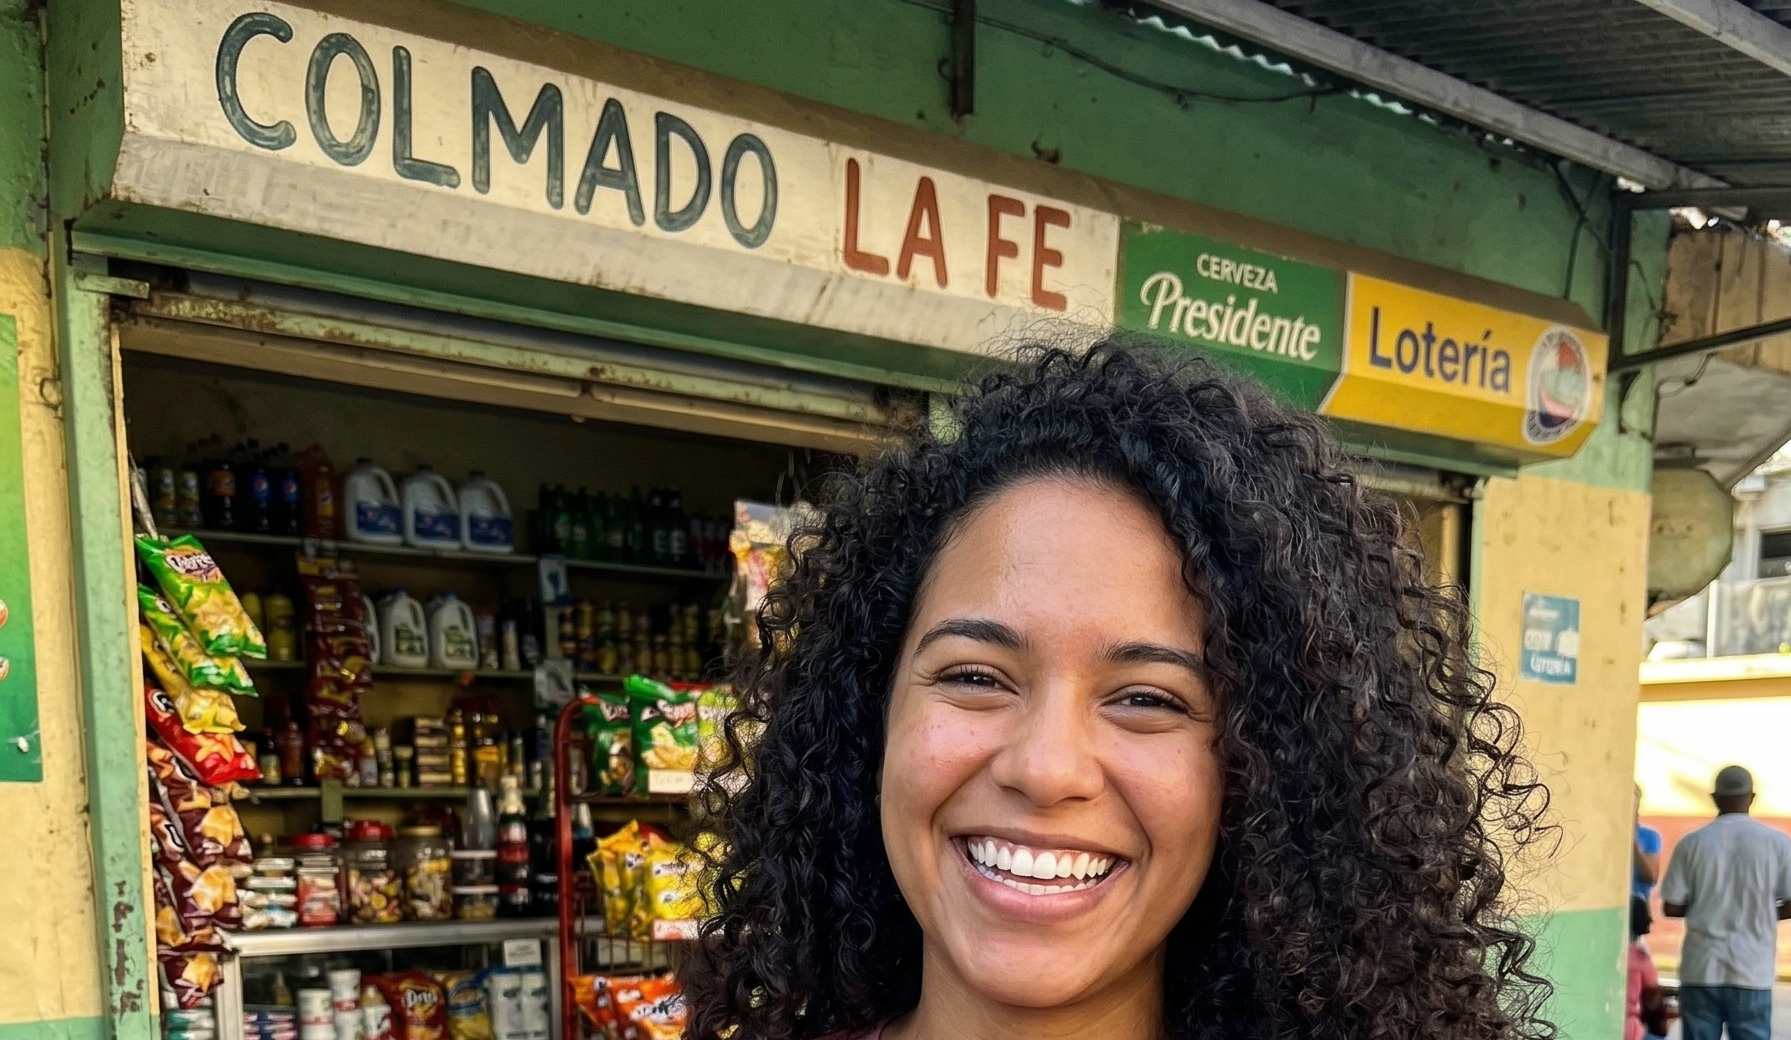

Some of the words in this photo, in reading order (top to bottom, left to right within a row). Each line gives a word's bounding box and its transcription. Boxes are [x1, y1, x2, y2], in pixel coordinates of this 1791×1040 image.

[215, 11, 778, 249] COLMADO
[842, 156, 949, 289] LA
[985, 193, 1072, 312] FE
[1140, 270, 1322, 361] Presidente
[1196, 252, 1279, 294] CERVEZA
[1370, 305, 1511, 394] Lotería
